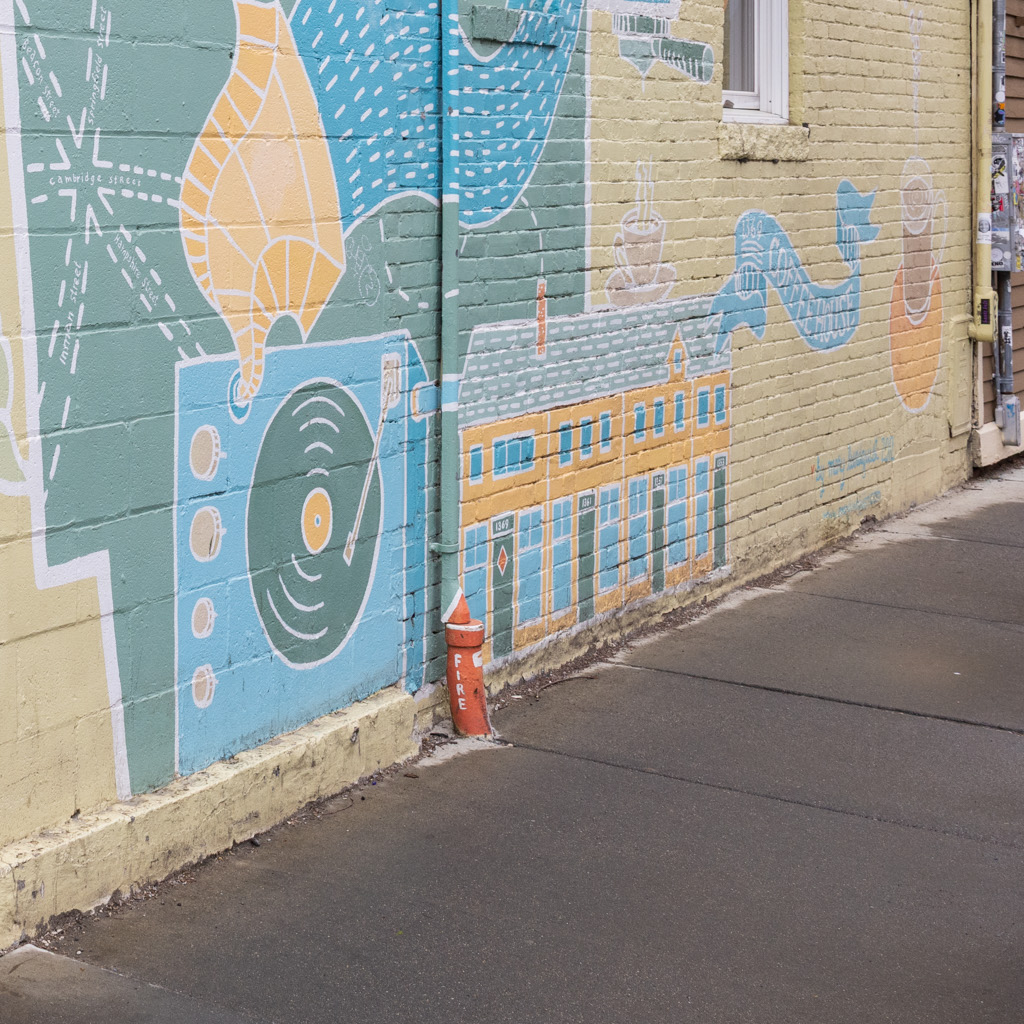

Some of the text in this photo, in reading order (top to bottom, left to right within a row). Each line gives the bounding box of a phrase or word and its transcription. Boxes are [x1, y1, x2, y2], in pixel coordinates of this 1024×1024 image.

[741, 216, 763, 241] 1369
[581, 496, 592, 508] 1361
[495, 518, 510, 532] 1369
[454, 653, 467, 711] FIRE
